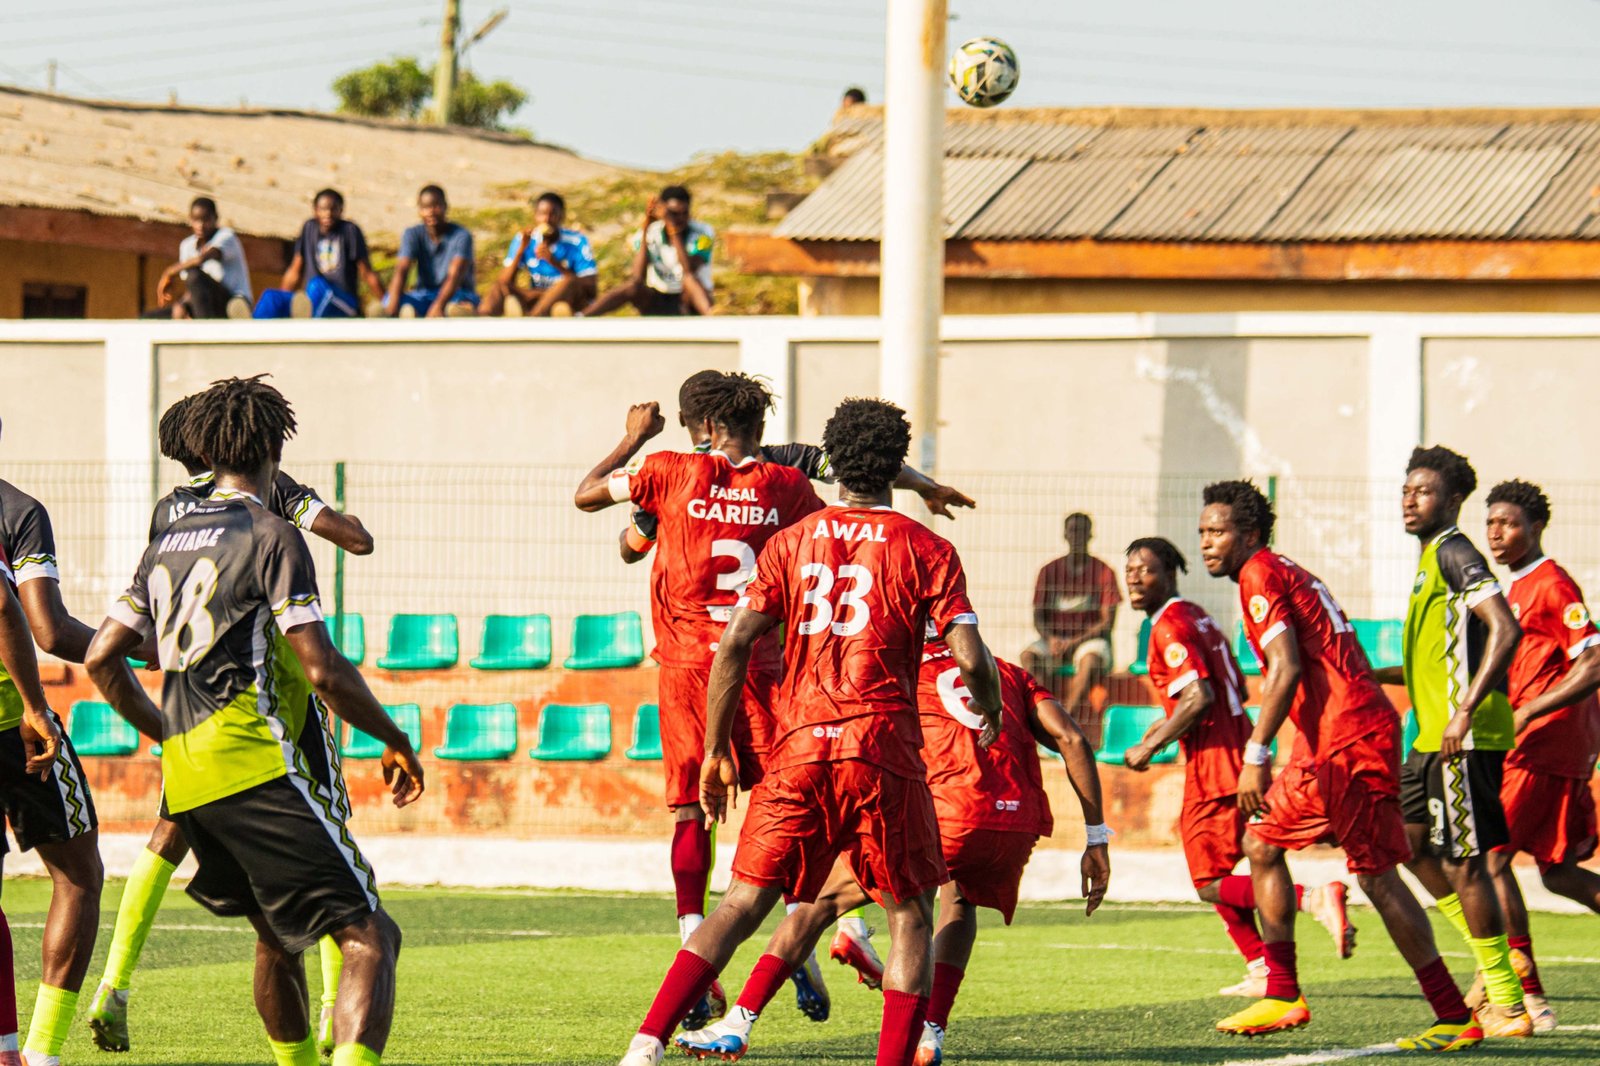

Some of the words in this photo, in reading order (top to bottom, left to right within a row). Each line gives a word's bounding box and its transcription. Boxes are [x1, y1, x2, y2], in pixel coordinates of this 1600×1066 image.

[709, 484, 759, 502] FAISAL
[687, 499, 779, 526] GARIBA
[812, 519, 887, 543] AWAL
[706, 539, 756, 622] 3
[798, 562, 873, 637] 33
